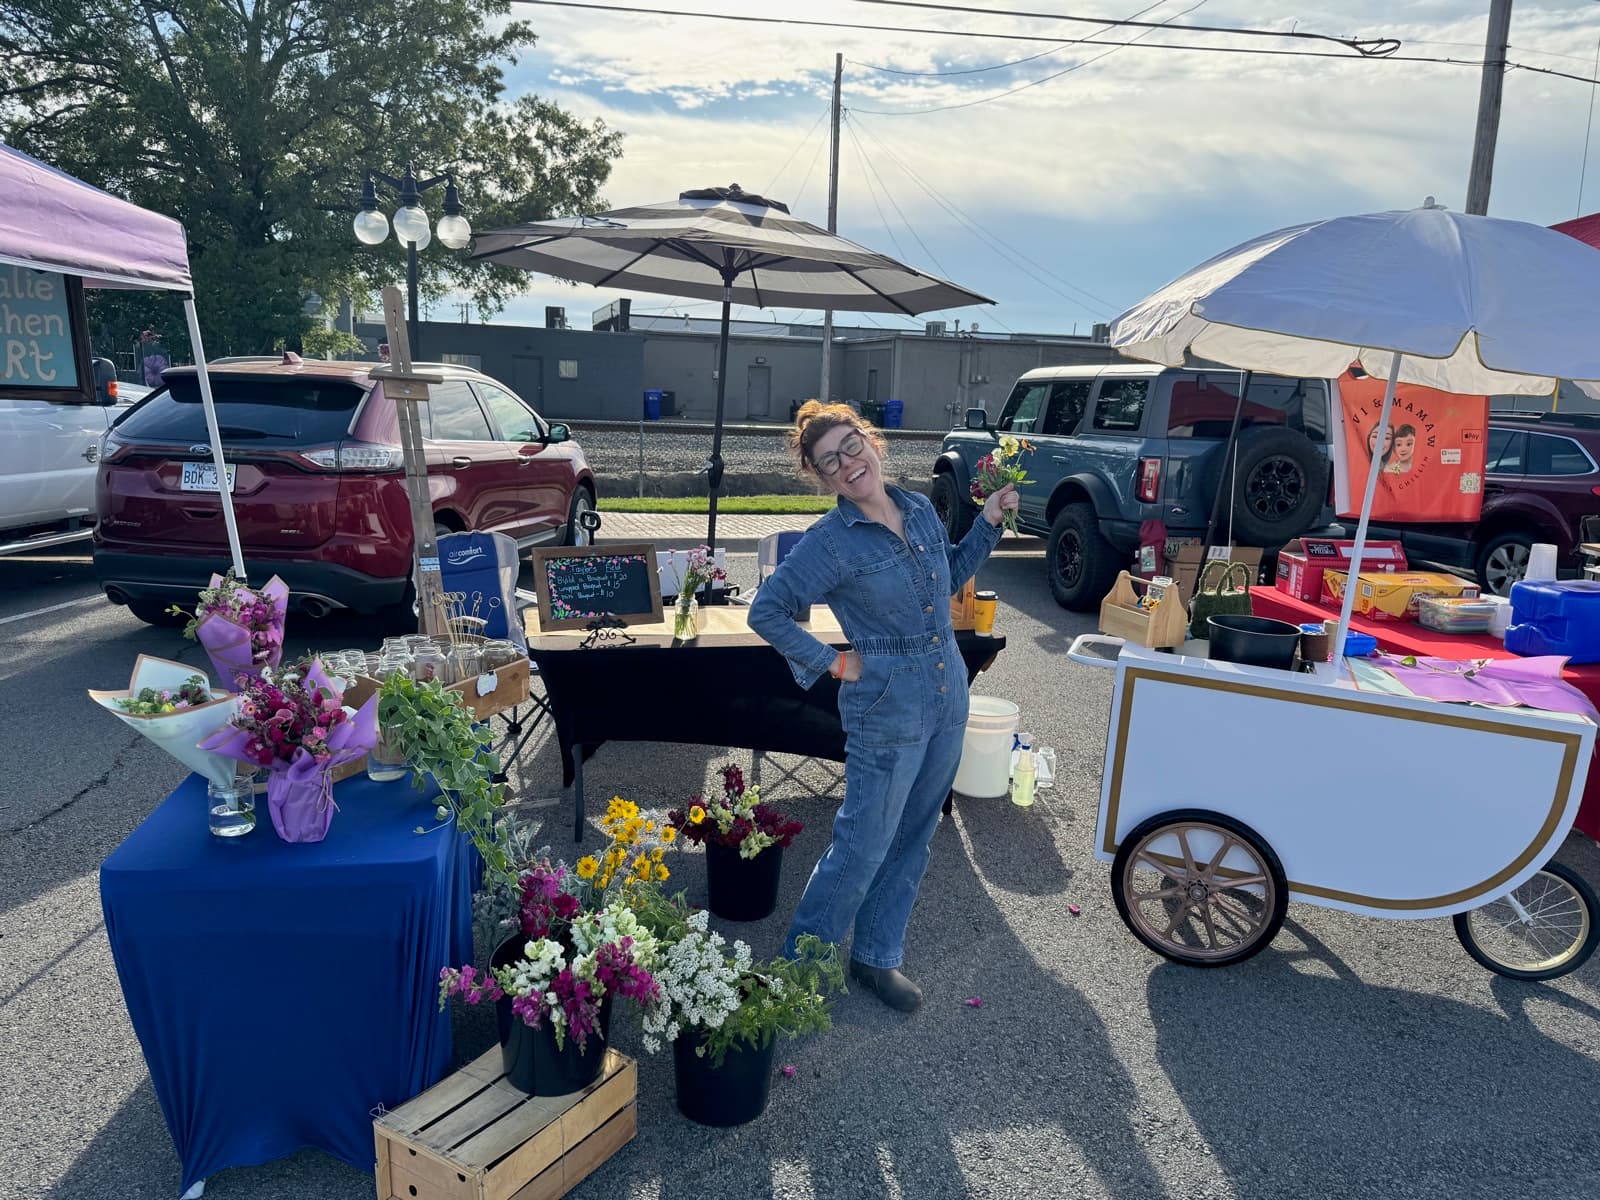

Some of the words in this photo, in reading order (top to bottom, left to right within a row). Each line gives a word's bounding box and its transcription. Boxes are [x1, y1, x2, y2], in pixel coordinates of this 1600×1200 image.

[0, 303, 64, 336] hen
[0, 339, 56, 381] Rt
[1391, 397, 1436, 448] MAMAW
[184, 471, 205, 484] BDK
